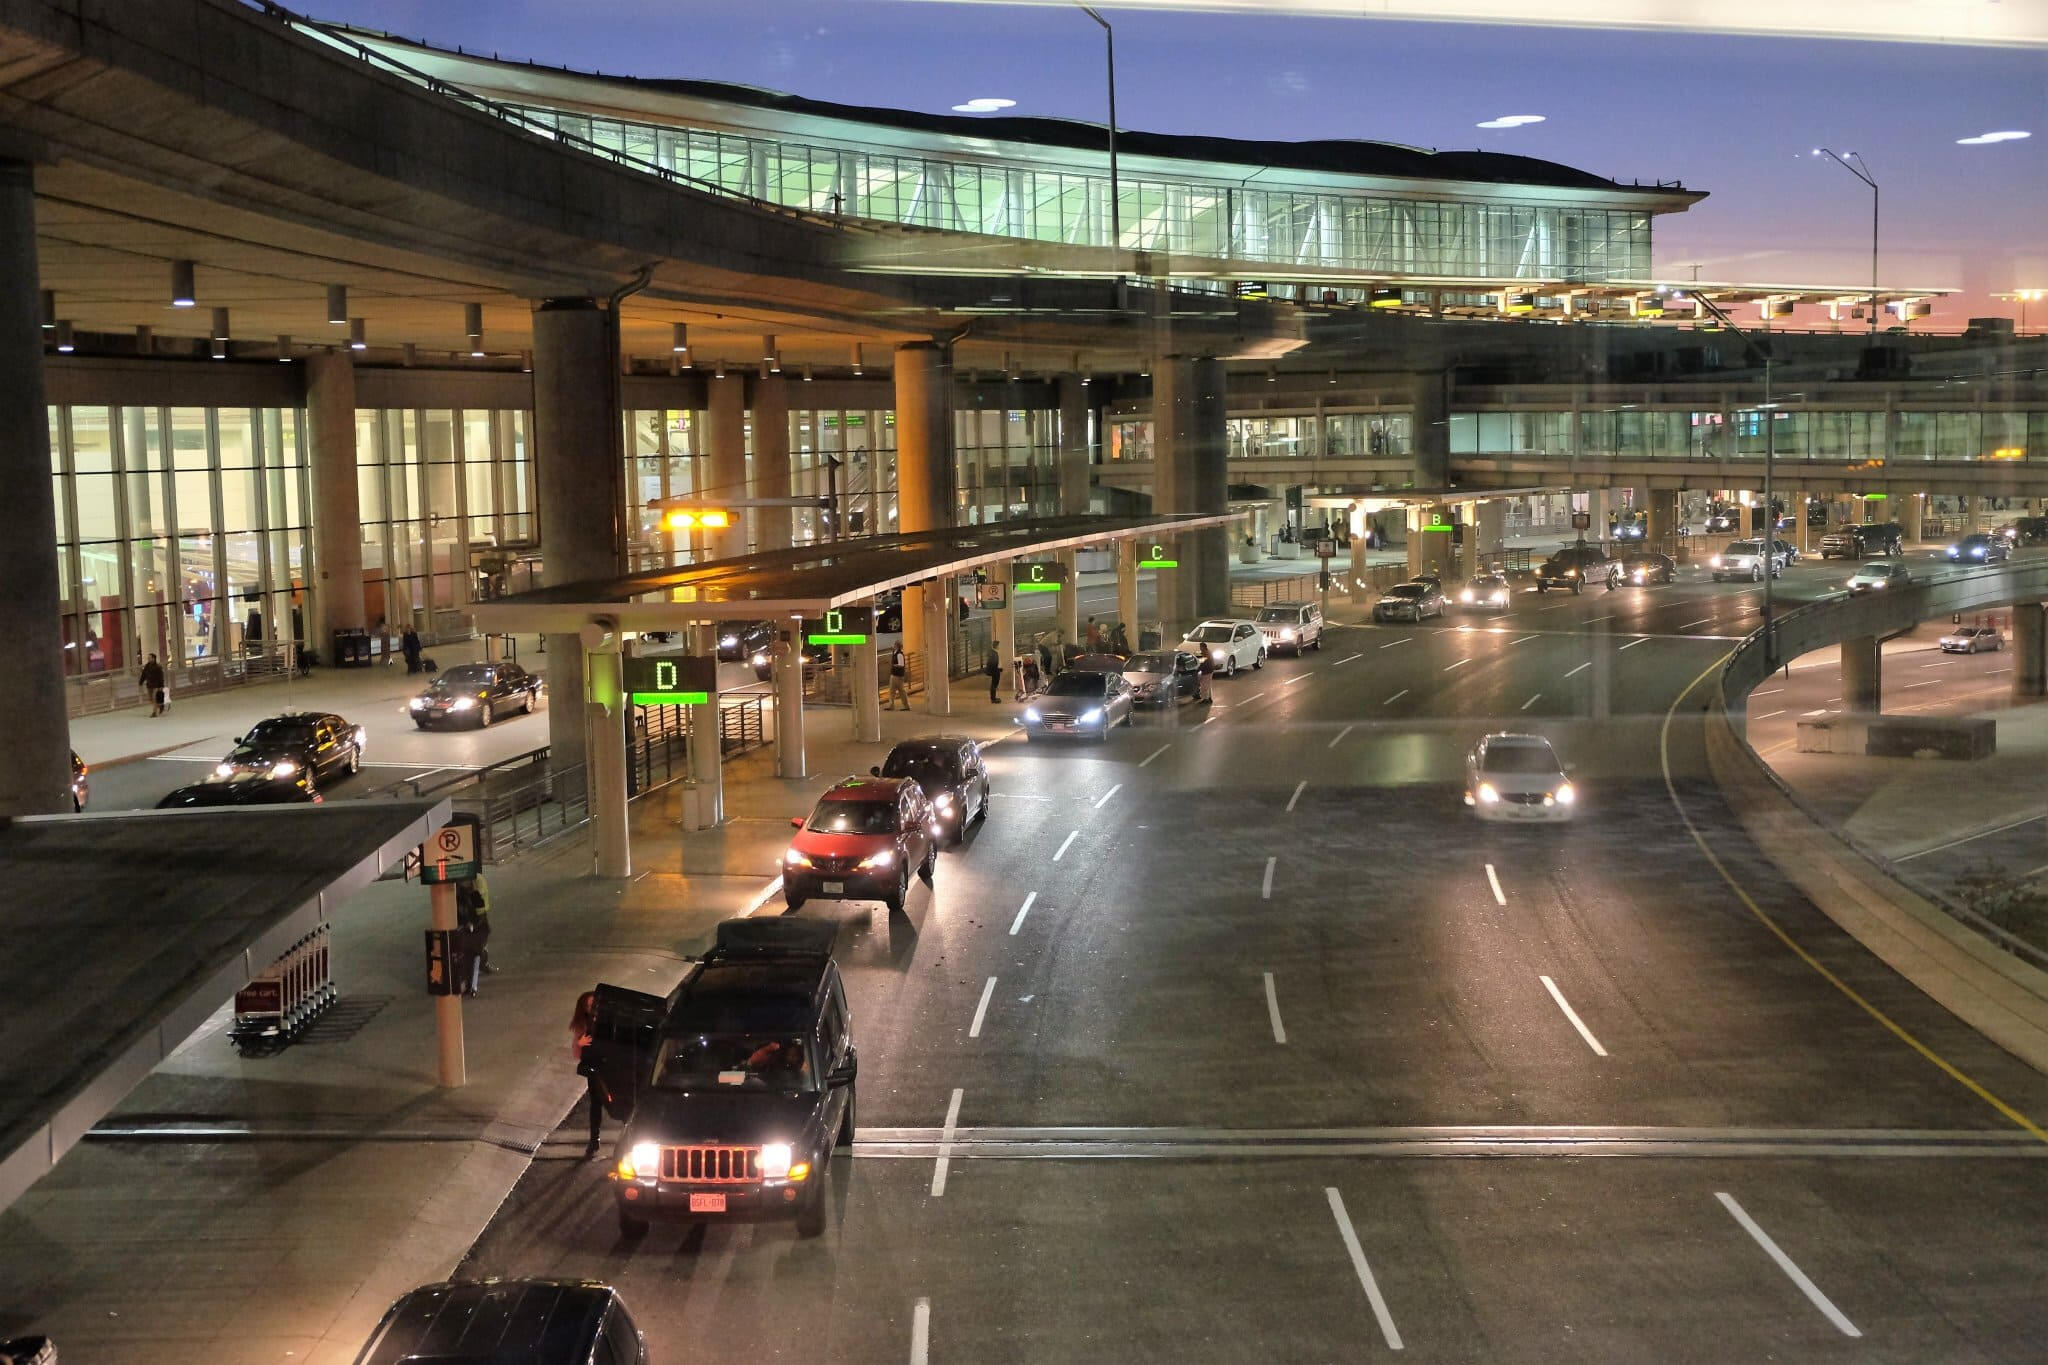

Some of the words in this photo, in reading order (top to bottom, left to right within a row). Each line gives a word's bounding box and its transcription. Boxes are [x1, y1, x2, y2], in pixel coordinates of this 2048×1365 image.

[1432, 513, 1441, 526] B
[1151, 545, 1164, 560] C
[1031, 565, 1044, 582] C
[826, 611, 843, 633] D
[656, 661, 677, 690] D
